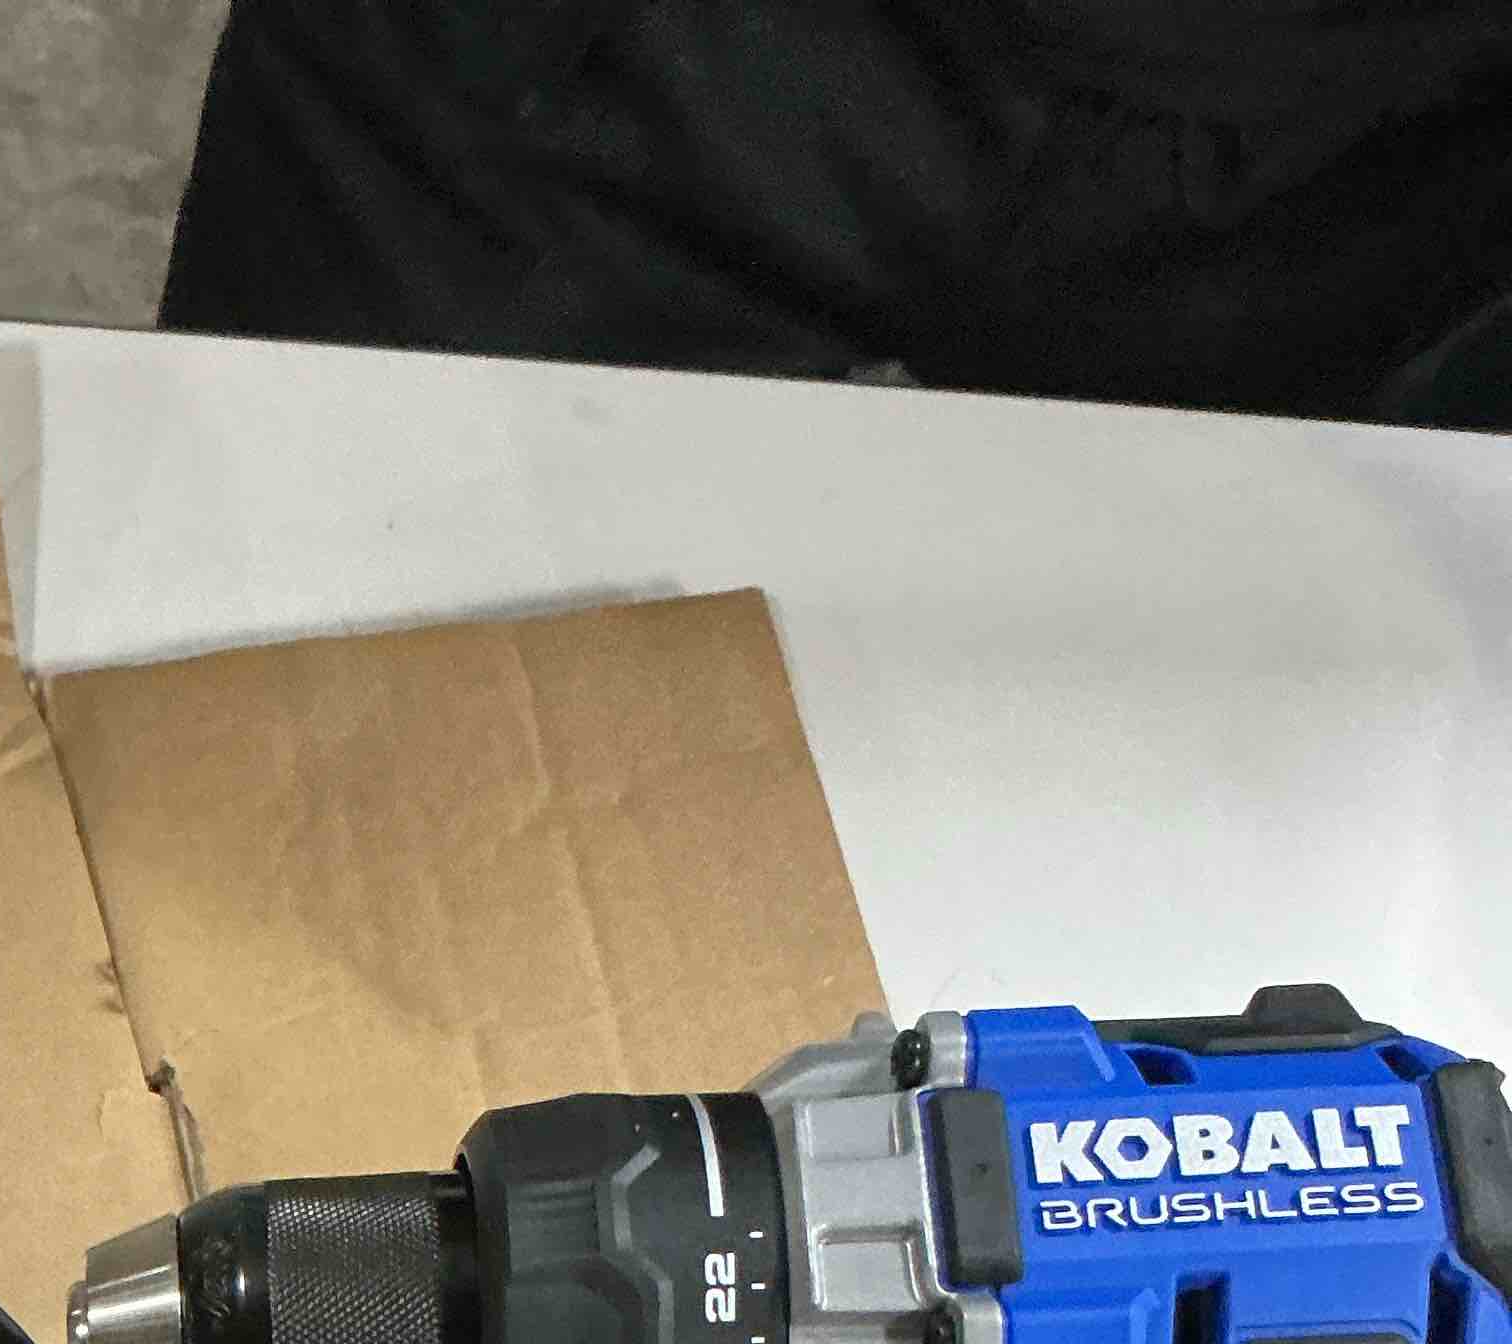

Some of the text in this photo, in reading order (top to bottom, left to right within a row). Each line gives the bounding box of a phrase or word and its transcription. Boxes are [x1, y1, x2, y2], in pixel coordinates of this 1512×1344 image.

[1028, 1105, 1412, 1185] KOBALT
[1038, 1181, 1426, 1231] BRUSHLESS
[703, 1251, 737, 1324] 22
